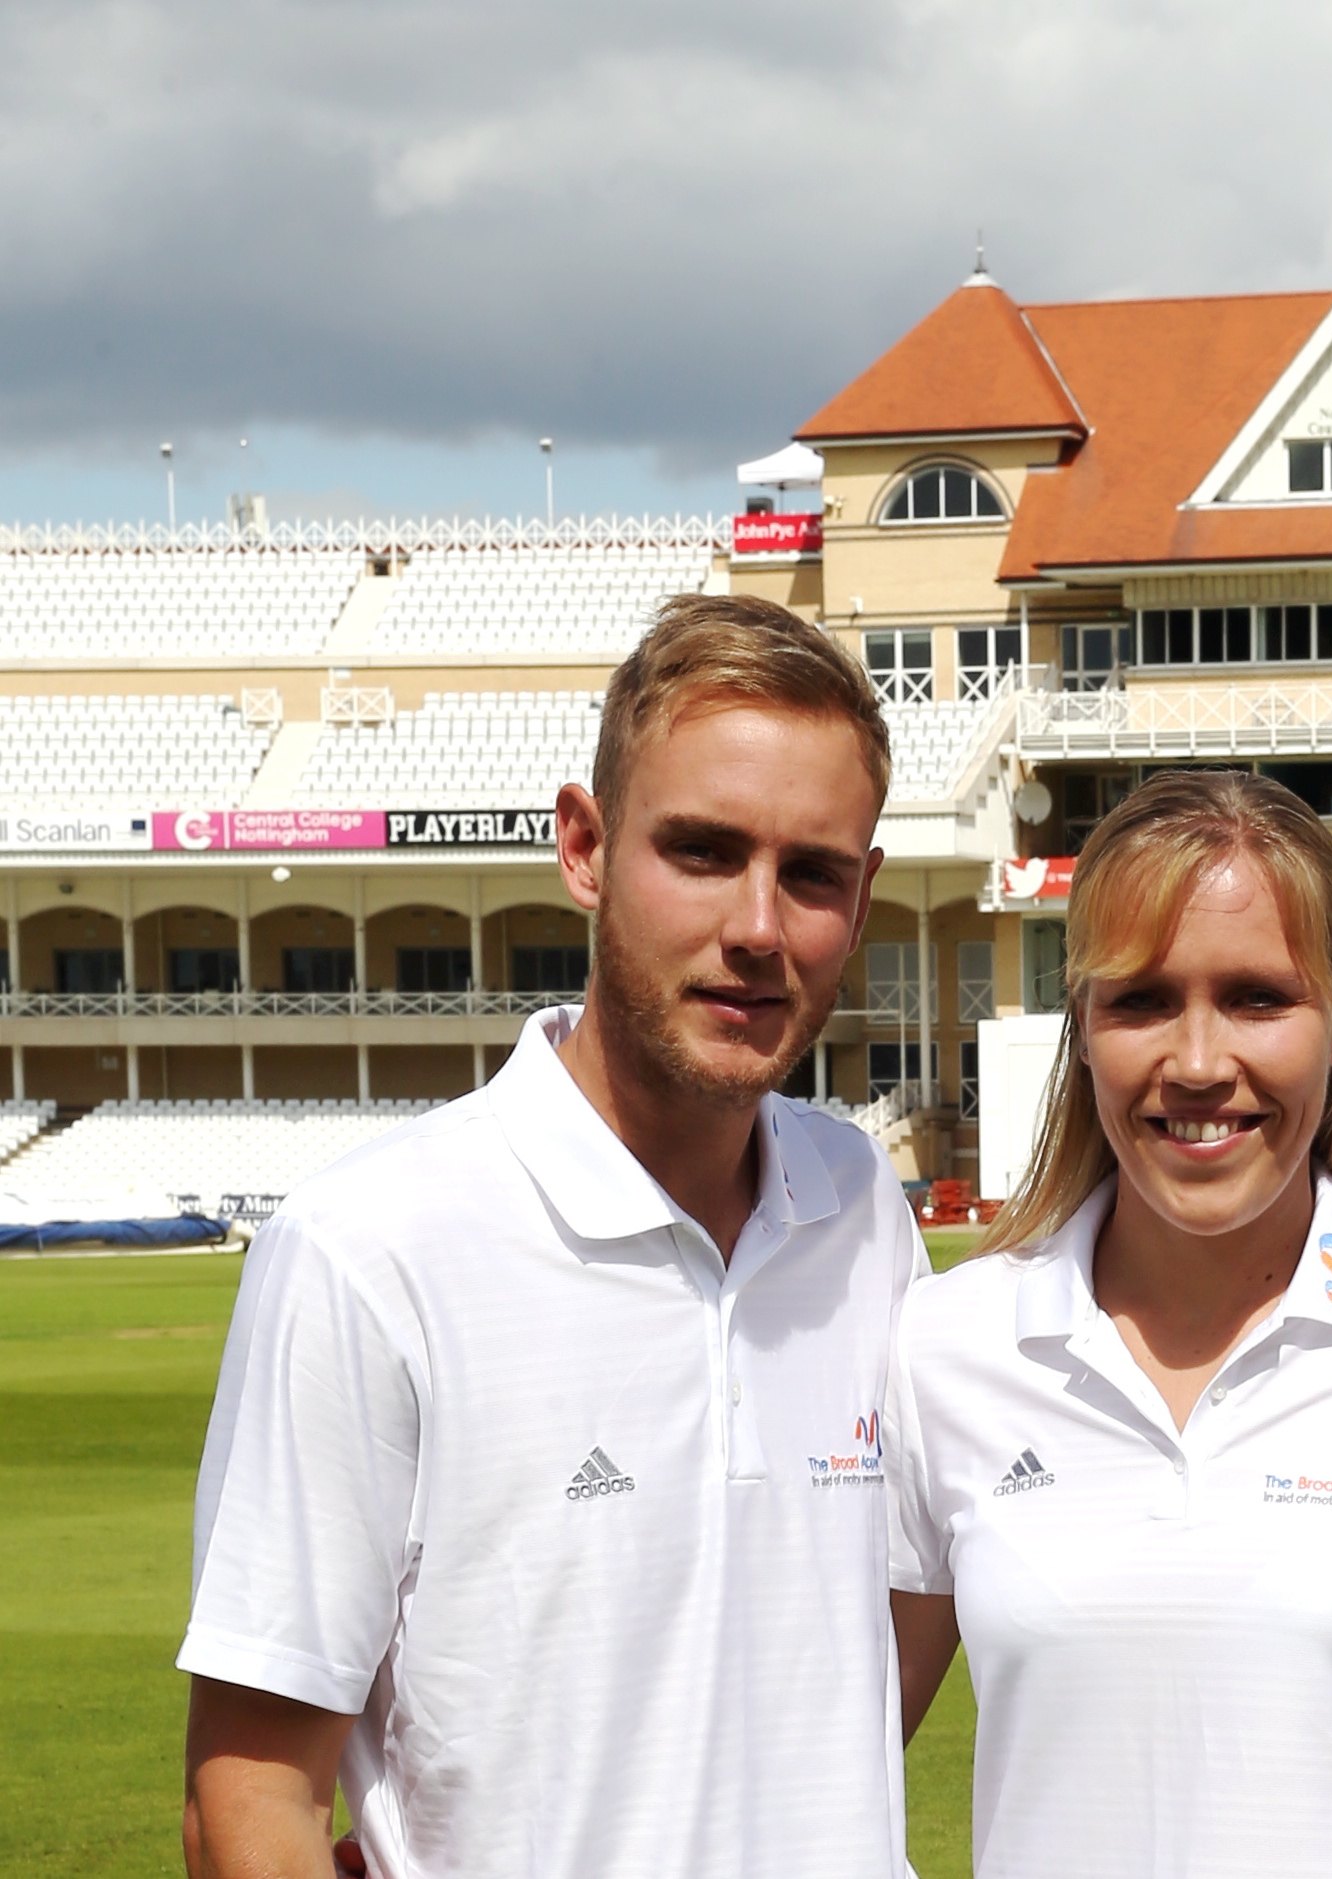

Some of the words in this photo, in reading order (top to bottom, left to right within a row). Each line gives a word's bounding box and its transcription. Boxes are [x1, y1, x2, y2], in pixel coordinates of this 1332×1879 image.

[734, 523, 769, 540] John
[769, 522, 796, 541] Pye
[16, 818, 111, 842] Scanlan
[234, 812, 296, 828] Central
[298, 812, 363, 831] College
[234, 828, 330, 846] Nottingham
[808, 1456, 828, 1472] The
[830, 1454, 860, 1471] Broad
[565, 1475, 636, 1500] adidas
[993, 1472, 1056, 1498] adidas
[1265, 1474, 1293, 1490] The
[1275, 1492, 1295, 1504] aid
[1295, 1492, 1310, 1504] of
